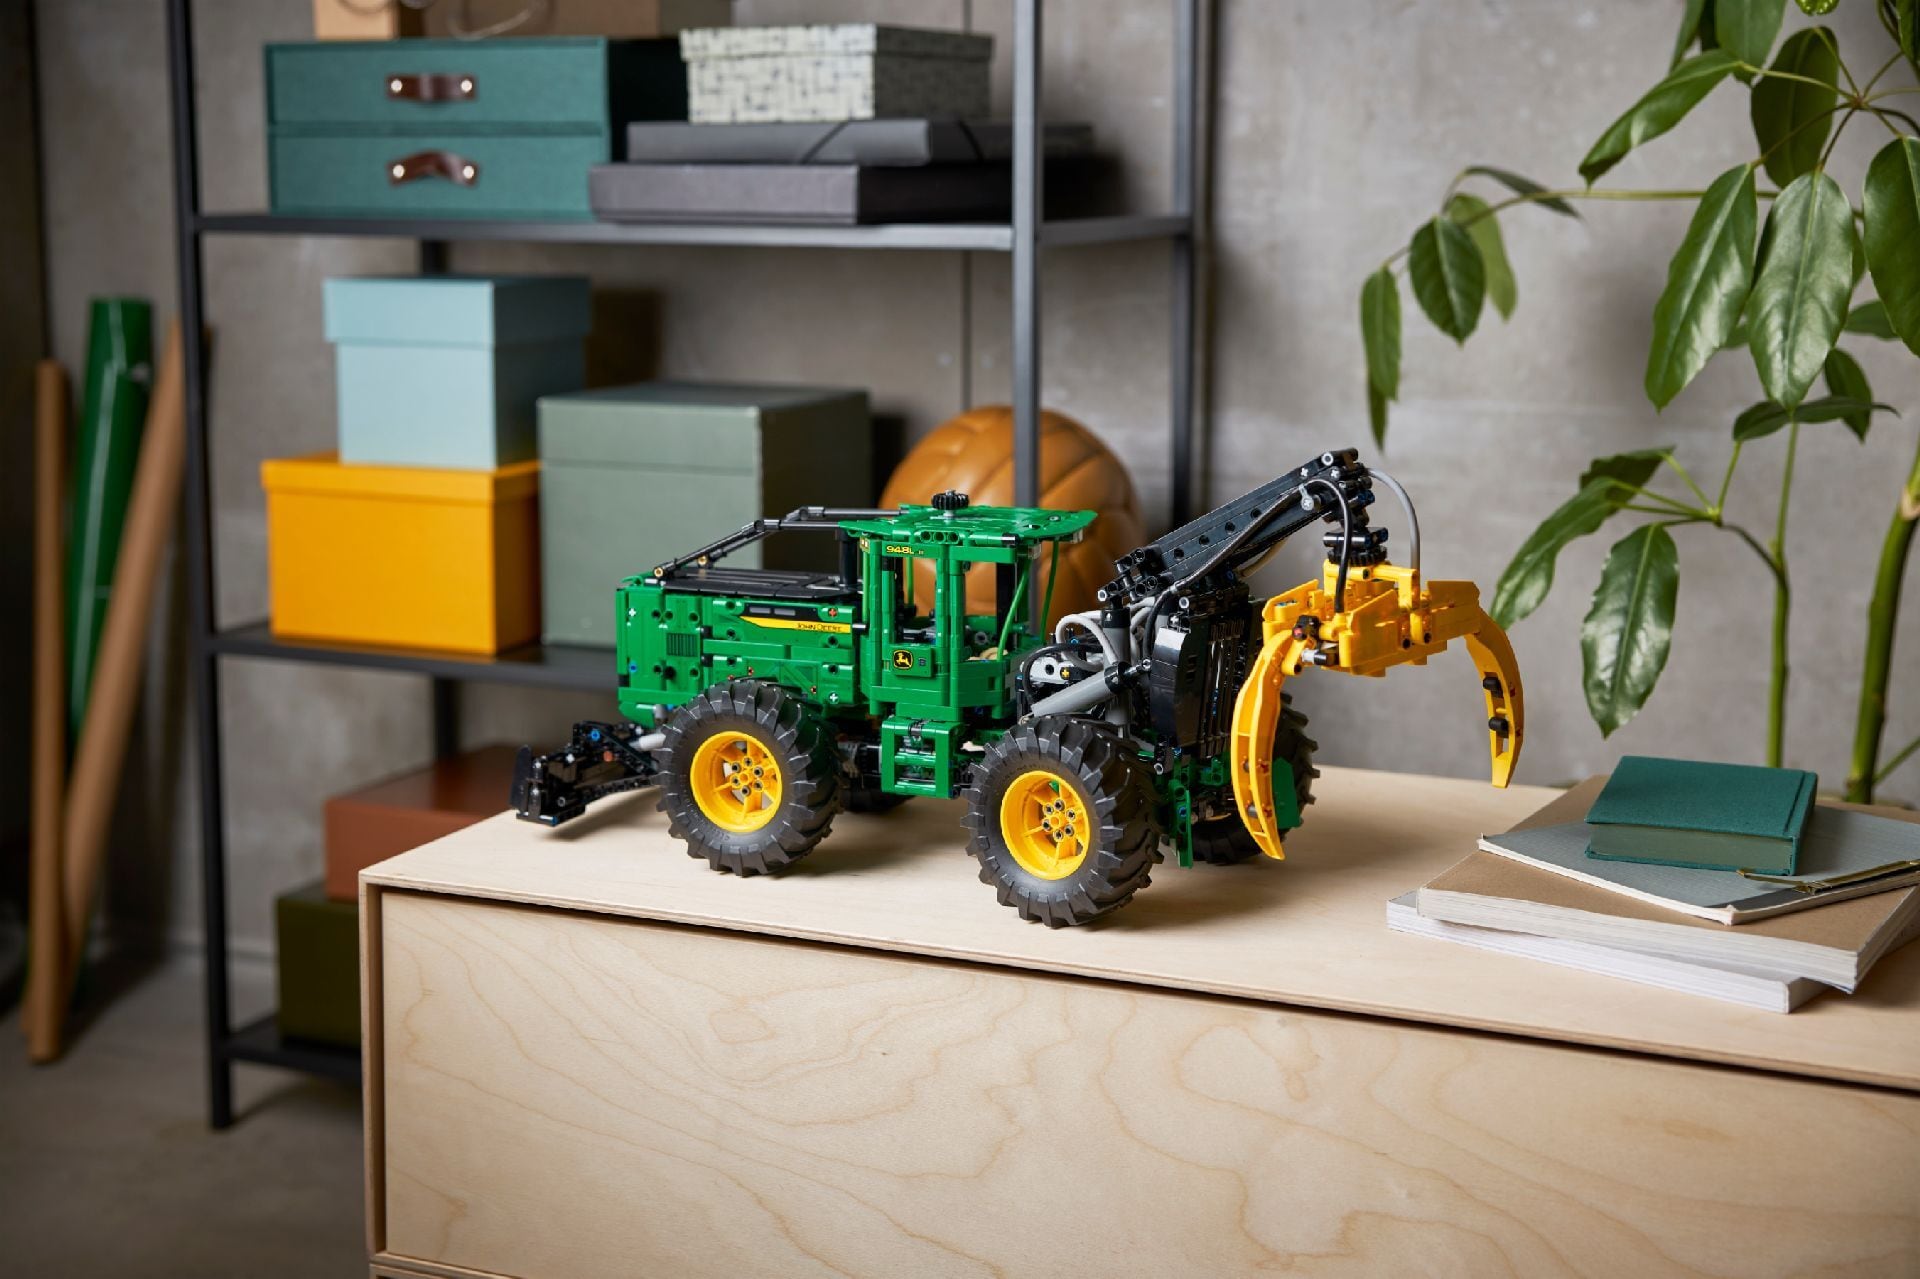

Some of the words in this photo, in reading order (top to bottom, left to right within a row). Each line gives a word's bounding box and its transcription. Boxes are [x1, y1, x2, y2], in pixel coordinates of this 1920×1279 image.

[886, 545, 914, 555] 948L
[797, 622, 816, 630] JOHN
[817, 623, 842, 632] DEERE
